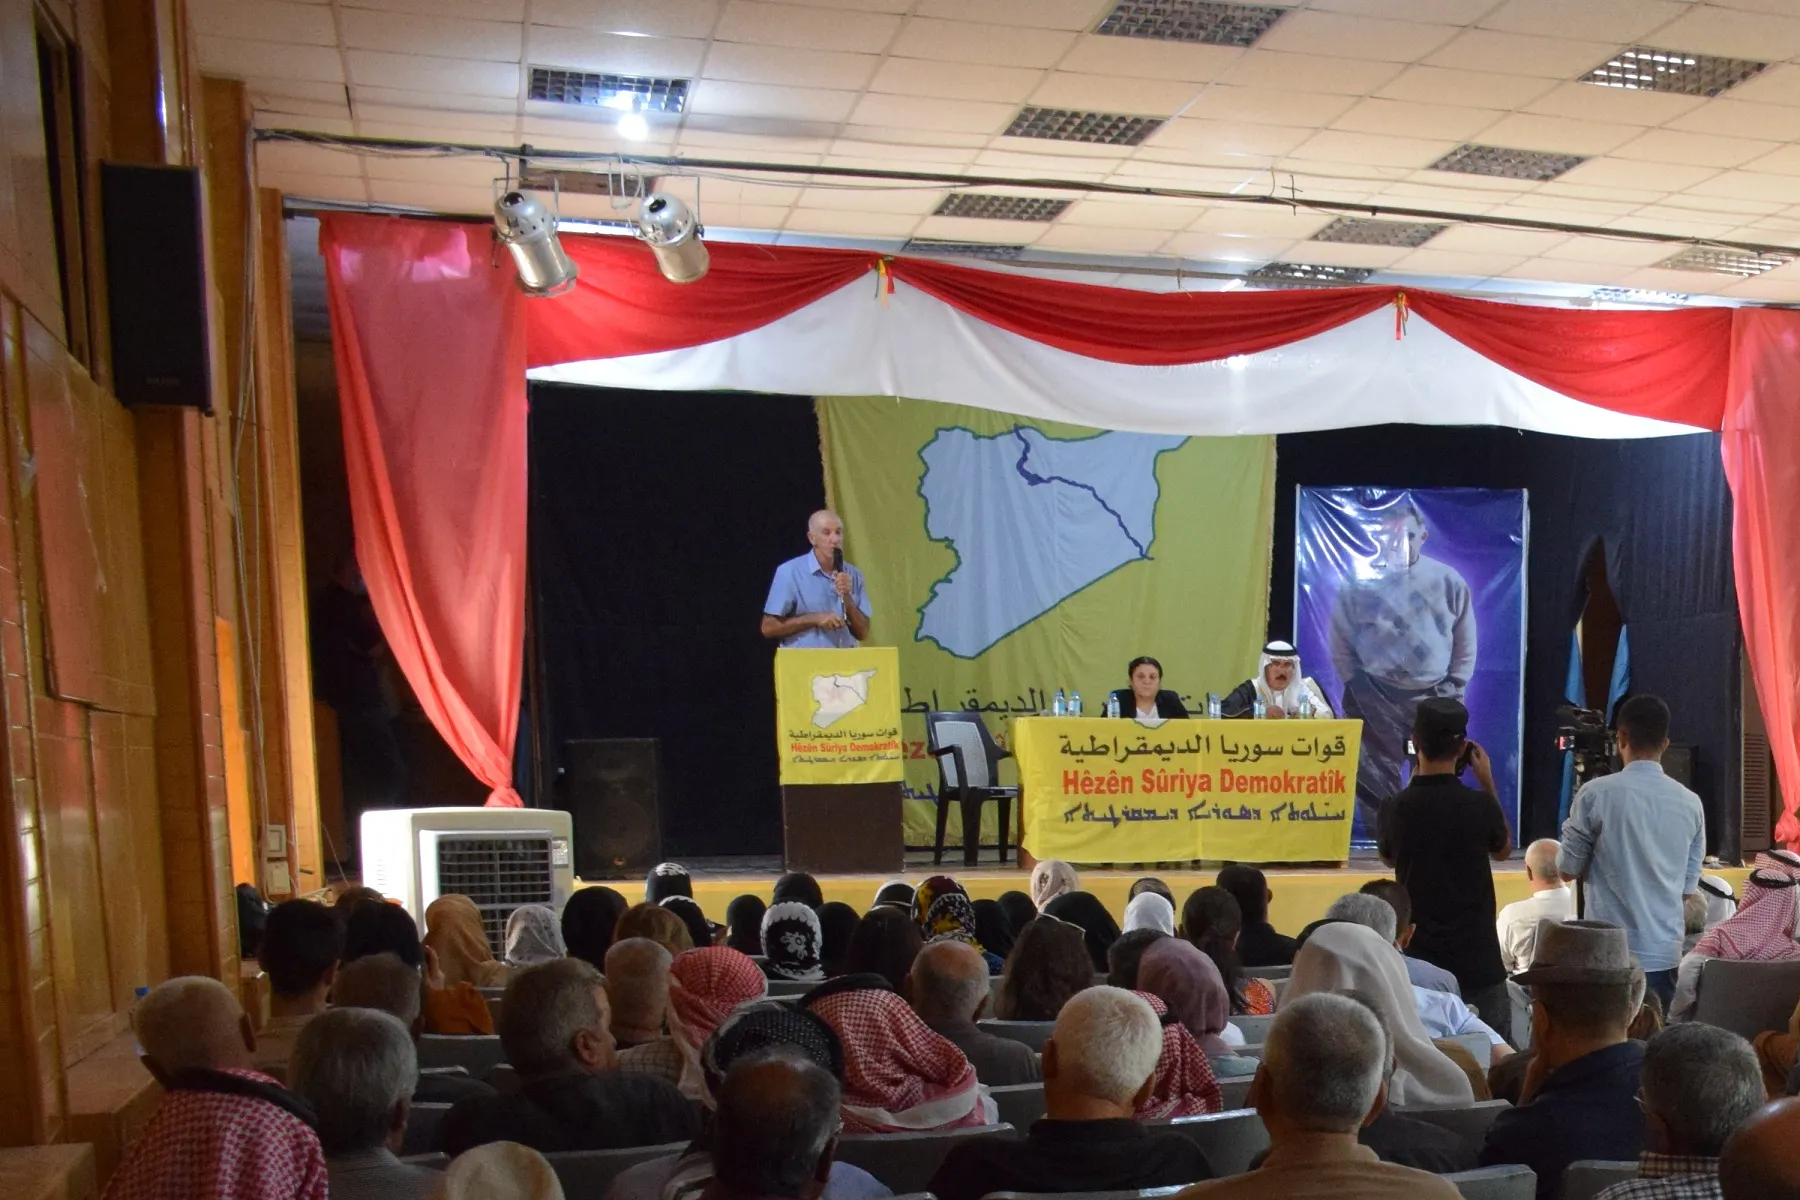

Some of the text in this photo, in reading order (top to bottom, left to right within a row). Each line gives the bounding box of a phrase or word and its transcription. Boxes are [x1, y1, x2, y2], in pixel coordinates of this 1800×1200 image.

[1060, 734, 1346, 764] قوات سوريا الديمقراطية
[1062, 767, 1346, 799] Hêzên Sûriya Demokratîk
